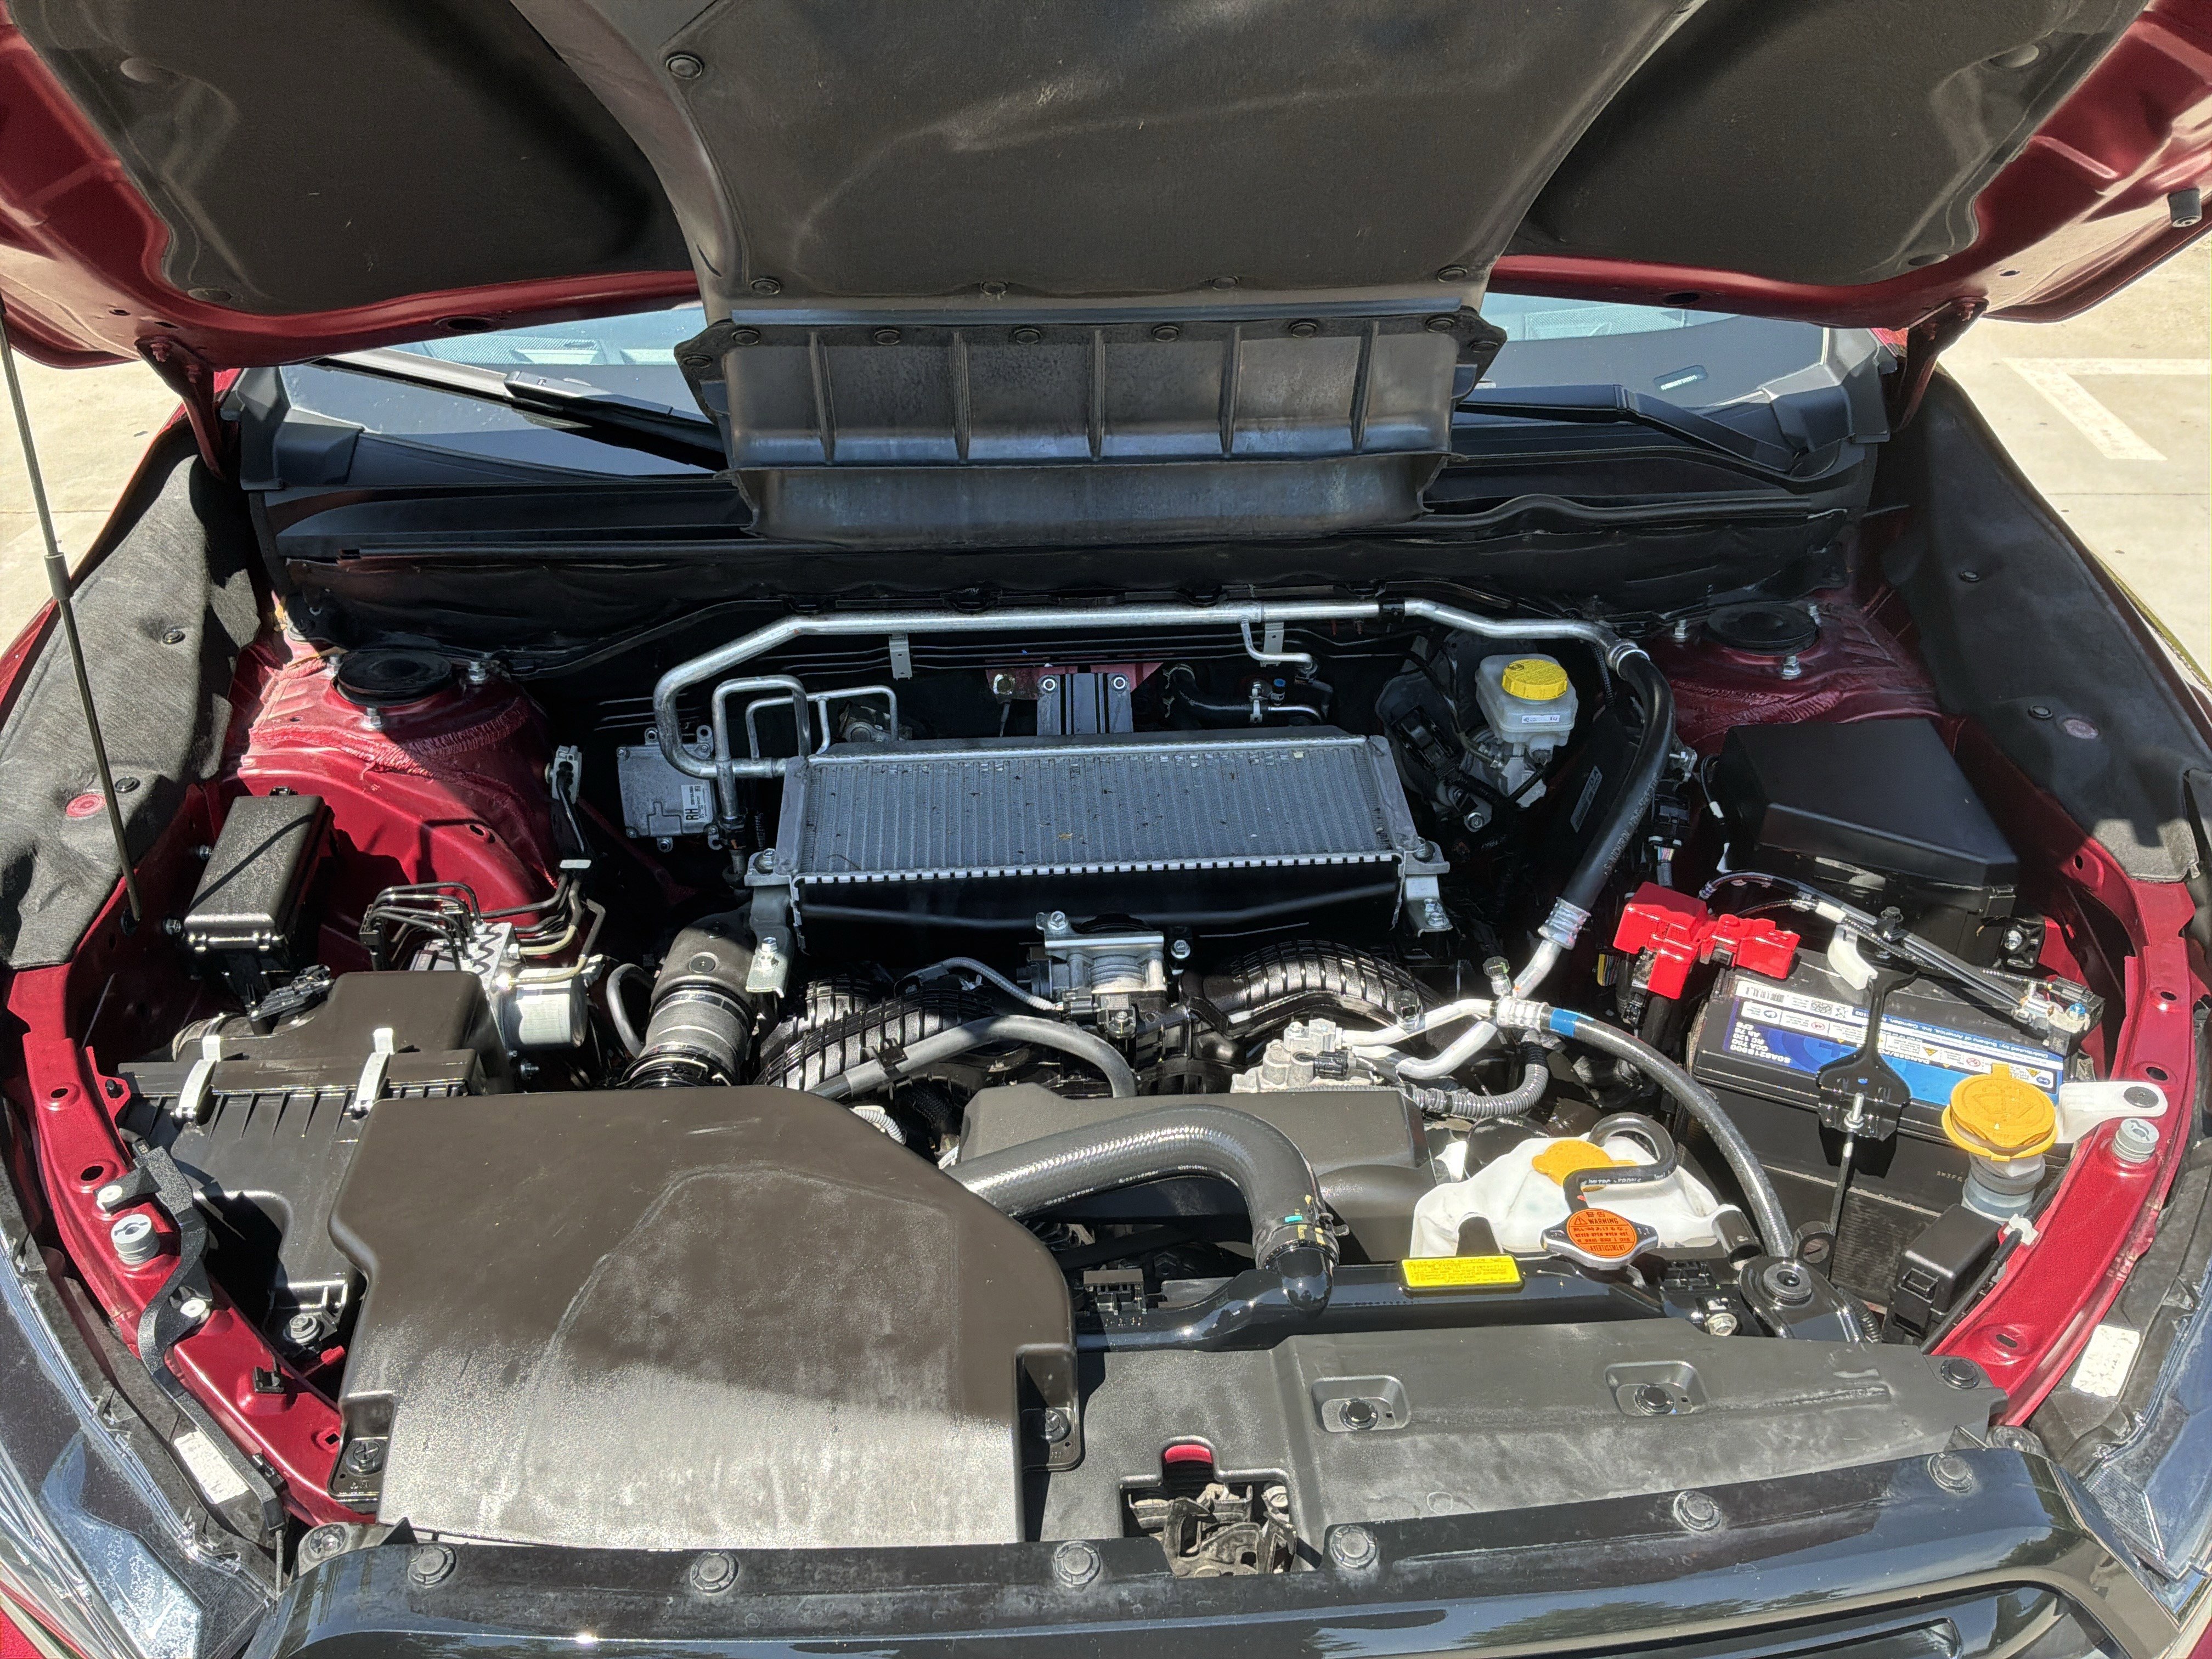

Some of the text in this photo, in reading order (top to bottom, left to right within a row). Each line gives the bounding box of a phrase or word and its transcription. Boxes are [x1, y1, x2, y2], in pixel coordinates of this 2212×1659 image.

[685, 808, 699, 820] RH
[1733, 1032, 1749, 1041] 120
[1973, 1037, 1997, 1047] Subaru
[1731, 1038, 1769, 1052] CCA 700
[2011, 1046, 2049, 1059] Distributed
